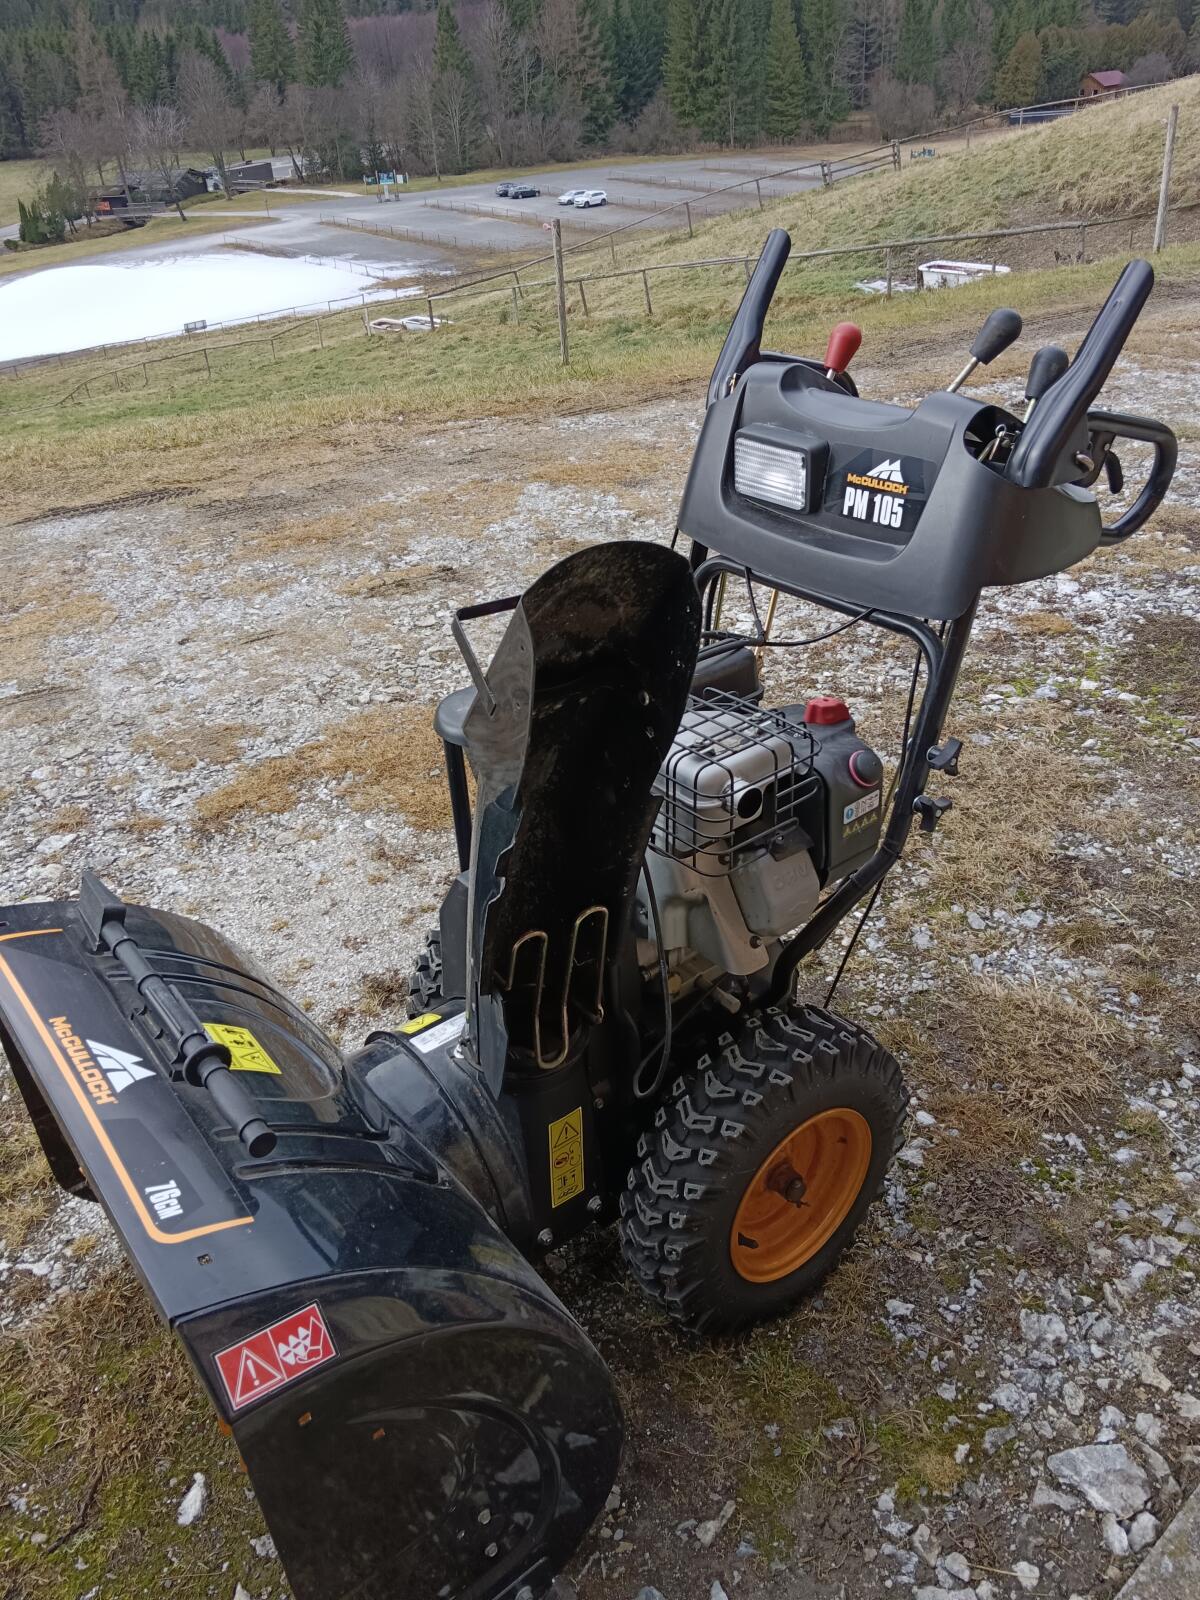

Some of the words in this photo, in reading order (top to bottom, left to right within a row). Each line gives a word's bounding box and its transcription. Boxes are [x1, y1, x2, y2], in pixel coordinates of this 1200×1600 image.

[847, 472, 908, 495] McCULLOCH
[843, 486, 870, 520] PM
[873, 493, 905, 528] 105
[48, 1016, 117, 1105] McCULLOCH
[145, 1179, 183, 1220] 76CM
